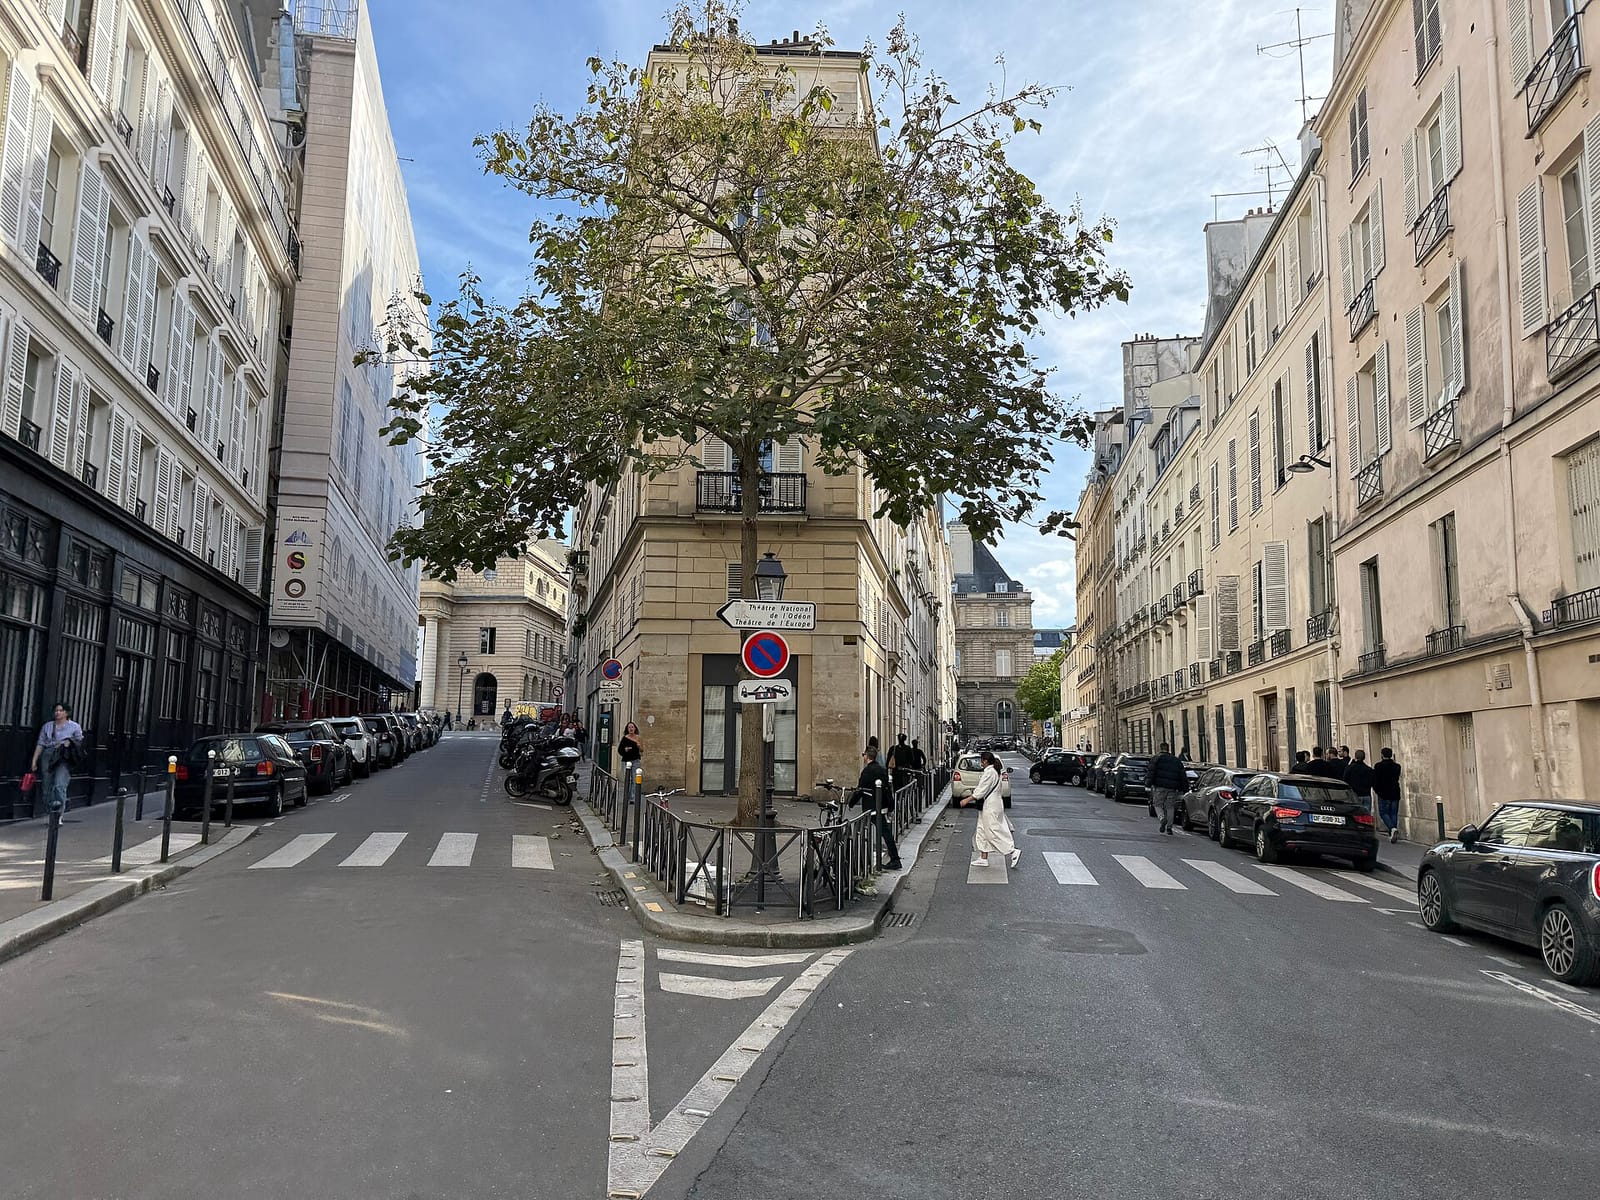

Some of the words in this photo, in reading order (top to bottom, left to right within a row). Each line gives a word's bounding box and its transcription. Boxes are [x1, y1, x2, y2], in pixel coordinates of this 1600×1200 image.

[780, 604, 812, 613] National
[782, 612, 812, 620] l'Odéon
[735, 618, 762, 626] Théâtre
[766, 619, 776, 627] de
[780, 620, 811, 628] l'Europe
